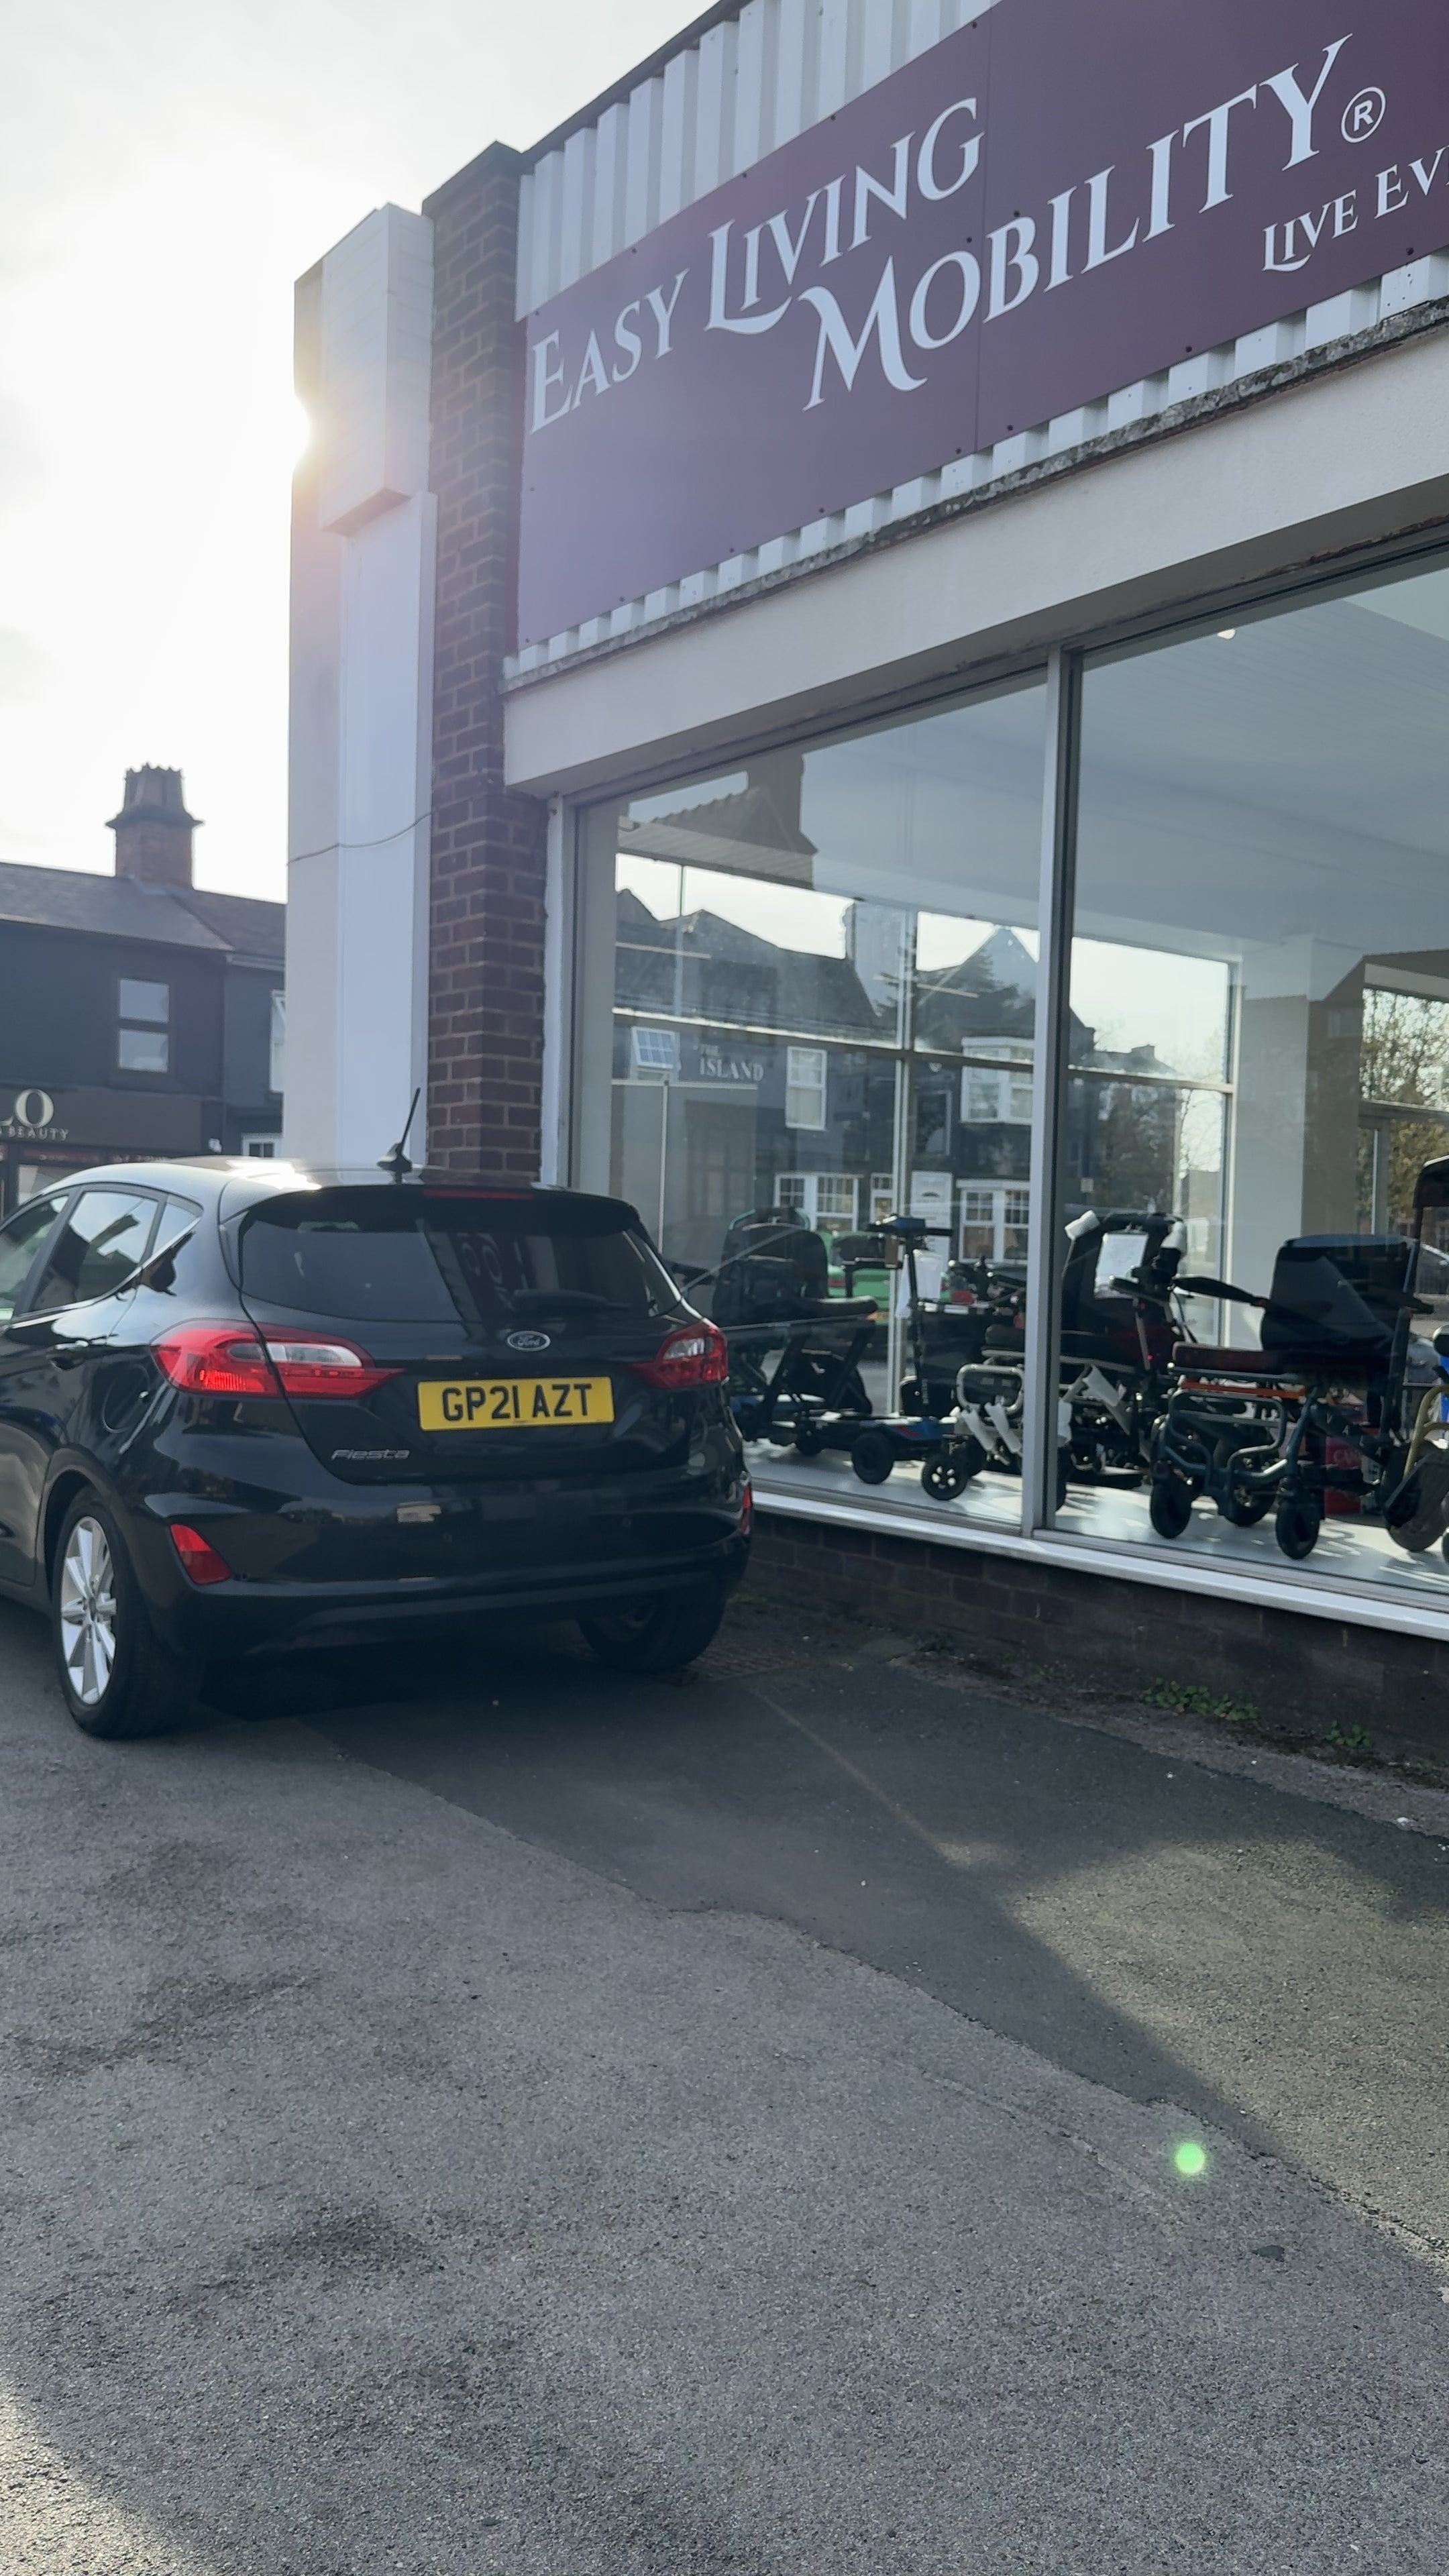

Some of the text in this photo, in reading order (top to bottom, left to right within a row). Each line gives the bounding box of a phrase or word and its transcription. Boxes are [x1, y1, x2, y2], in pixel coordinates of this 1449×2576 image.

[798, 33, 1353, 412] MOBILITY
[1263, 144, 1449, 272] LIVE EV
[530, 97, 985, 435] EASY LIVING
[699, 1057, 764, 1081] ISLAND
[8, 1126, 69, 1140] BEAUTY
[442, 1383, 592, 1421] GP21 AZT
[331, 1449, 410, 1460] Fiesta
